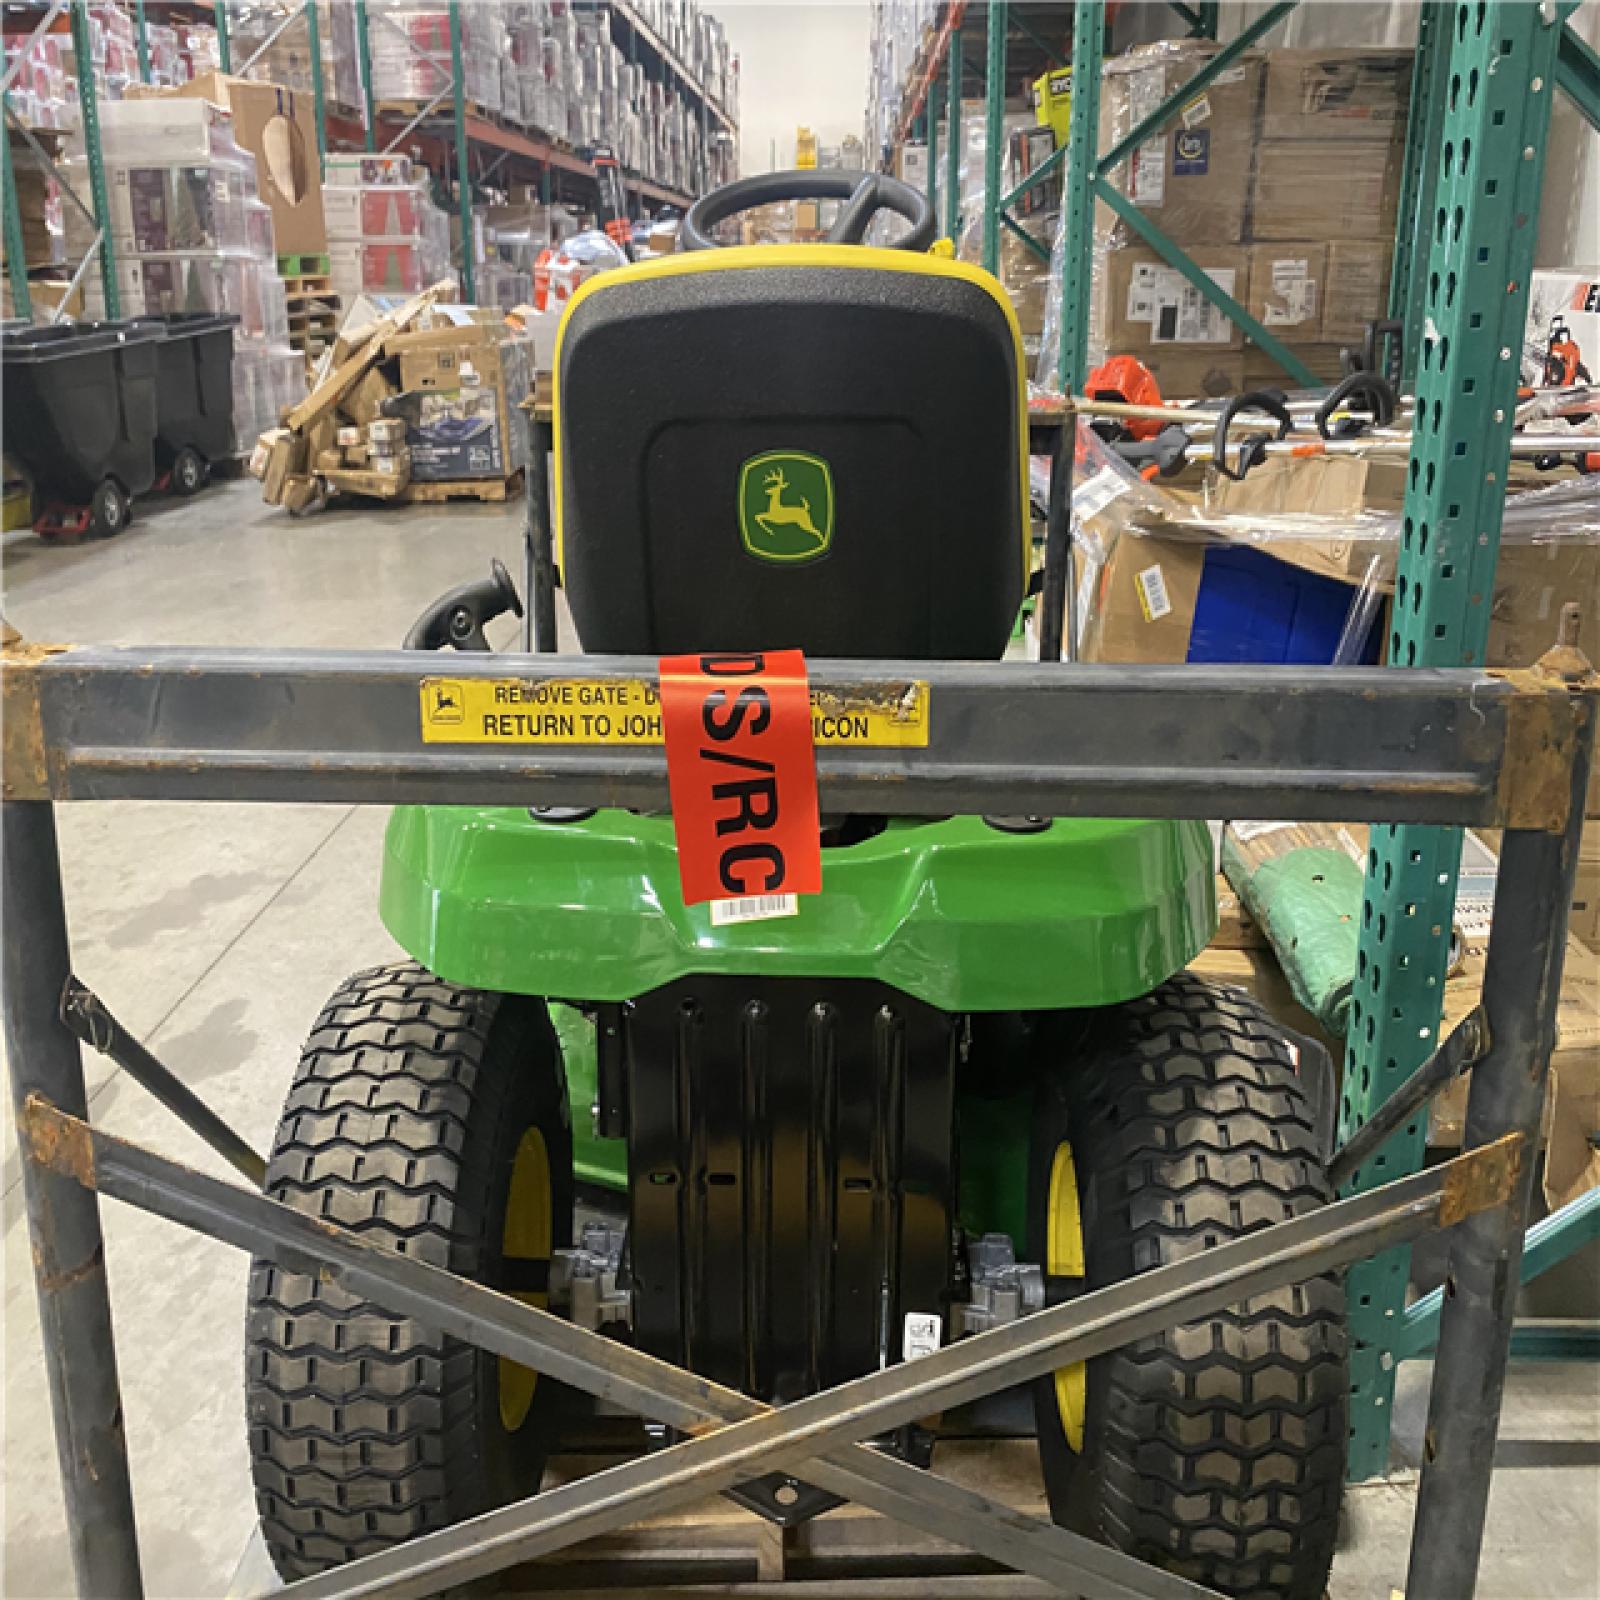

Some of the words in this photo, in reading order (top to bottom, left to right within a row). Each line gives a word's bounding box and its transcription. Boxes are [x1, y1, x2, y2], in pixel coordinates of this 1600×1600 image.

[579, 687, 628, 705] GATE
[483, 714, 574, 736] RETURN
[580, 714, 611, 736] TO
[617, 714, 663, 737] JOH
[813, 716, 868, 738] ICON
